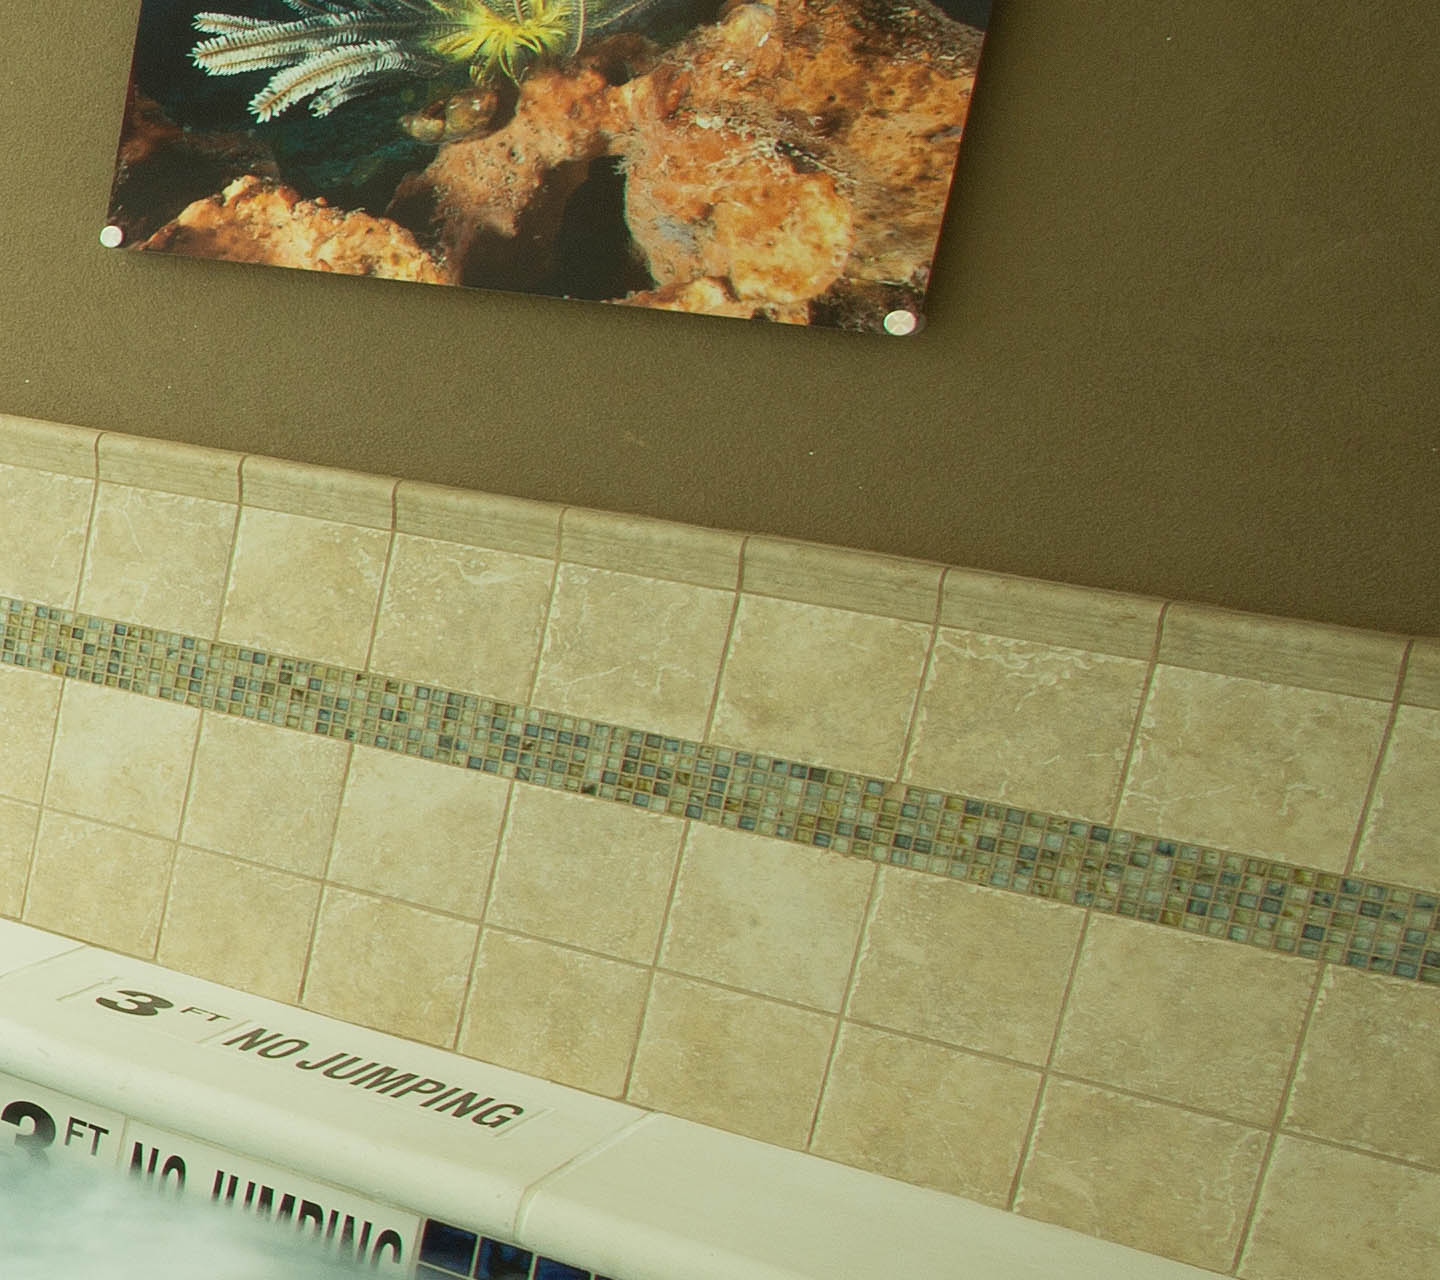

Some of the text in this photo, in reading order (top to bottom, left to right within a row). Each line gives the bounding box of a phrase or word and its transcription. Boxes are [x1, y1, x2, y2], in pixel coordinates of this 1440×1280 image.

[95, 989, 525, 1129] 3 FT NO JUMPING
[63, 1115, 110, 1157] FT
